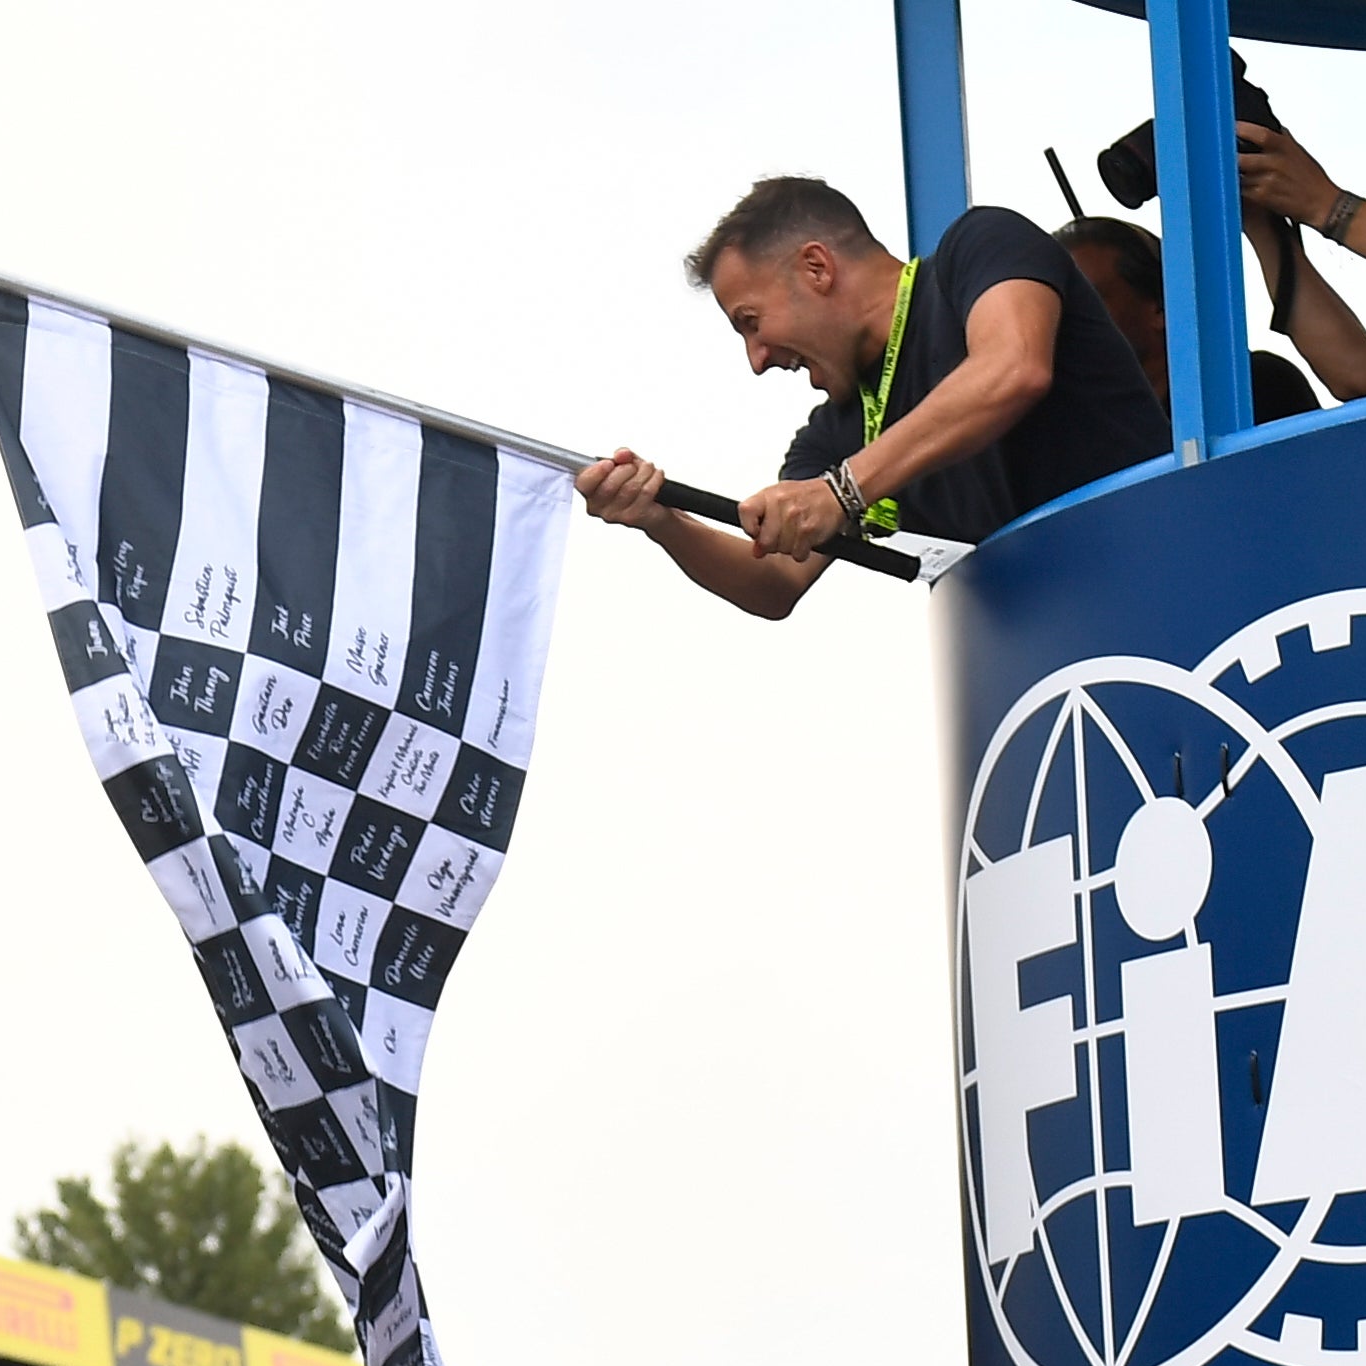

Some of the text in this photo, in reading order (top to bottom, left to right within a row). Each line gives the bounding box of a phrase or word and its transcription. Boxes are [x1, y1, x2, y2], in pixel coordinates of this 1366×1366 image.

[184, 563, 213, 630] Sebastien
[210, 564, 241, 639] Palmquist
[271, 604, 290, 640] Jack
[293, 612, 313, 649] Price
[170, 663, 194, 705] John
[194, 665, 231, 715] Thang
[414, 648, 441, 713] Cameron
[436, 660, 460, 718] Jenkins
[306, 701, 339, 761] Elisabetta
[237, 775, 259, 810] Tony
[249, 762, 274, 840] Cheetham
[459, 772, 482, 816] Chloe
[301, 812, 316, 828] C
[314, 807, 337, 848] Ayala
[349, 823, 377, 865] Pedro
[367, 824, 409, 881] Verdugo
[427, 858, 452, 891] Olga
[329, 910, 346, 947] Lena
